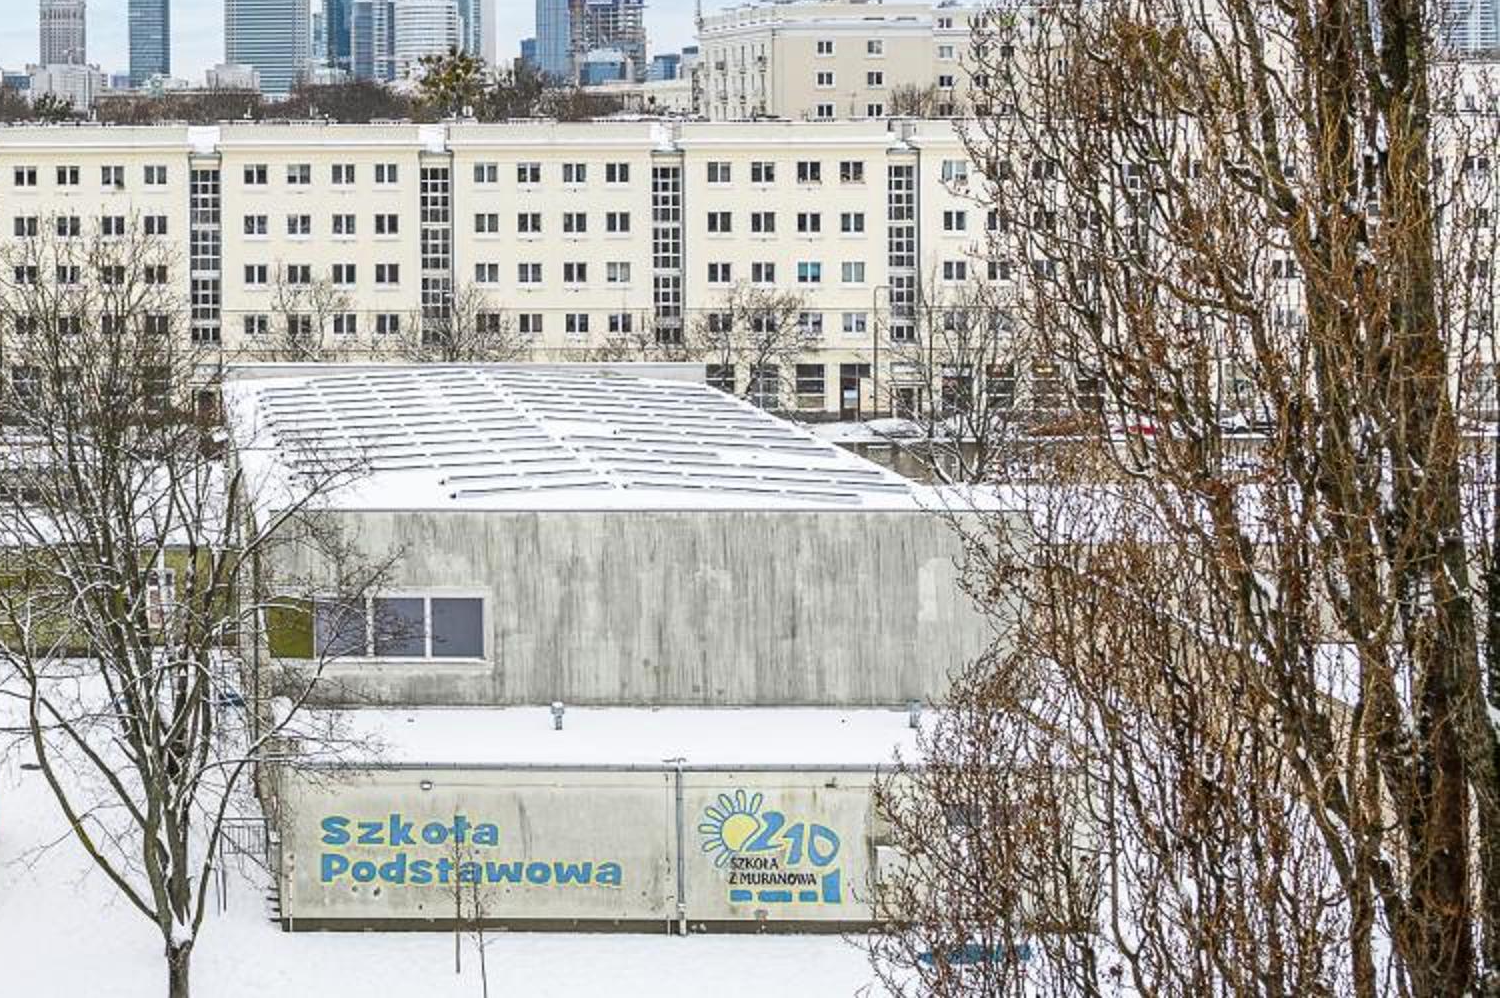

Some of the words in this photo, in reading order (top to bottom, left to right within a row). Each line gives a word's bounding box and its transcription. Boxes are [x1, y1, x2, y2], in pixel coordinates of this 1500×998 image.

[320, 813, 499, 846] Szkoła
[745, 811, 841, 867] 210
[320, 852, 623, 885] Podstawowa
[730, 857, 779, 871] SZKOŁA
[739, 872, 818, 886] MURANOWA
